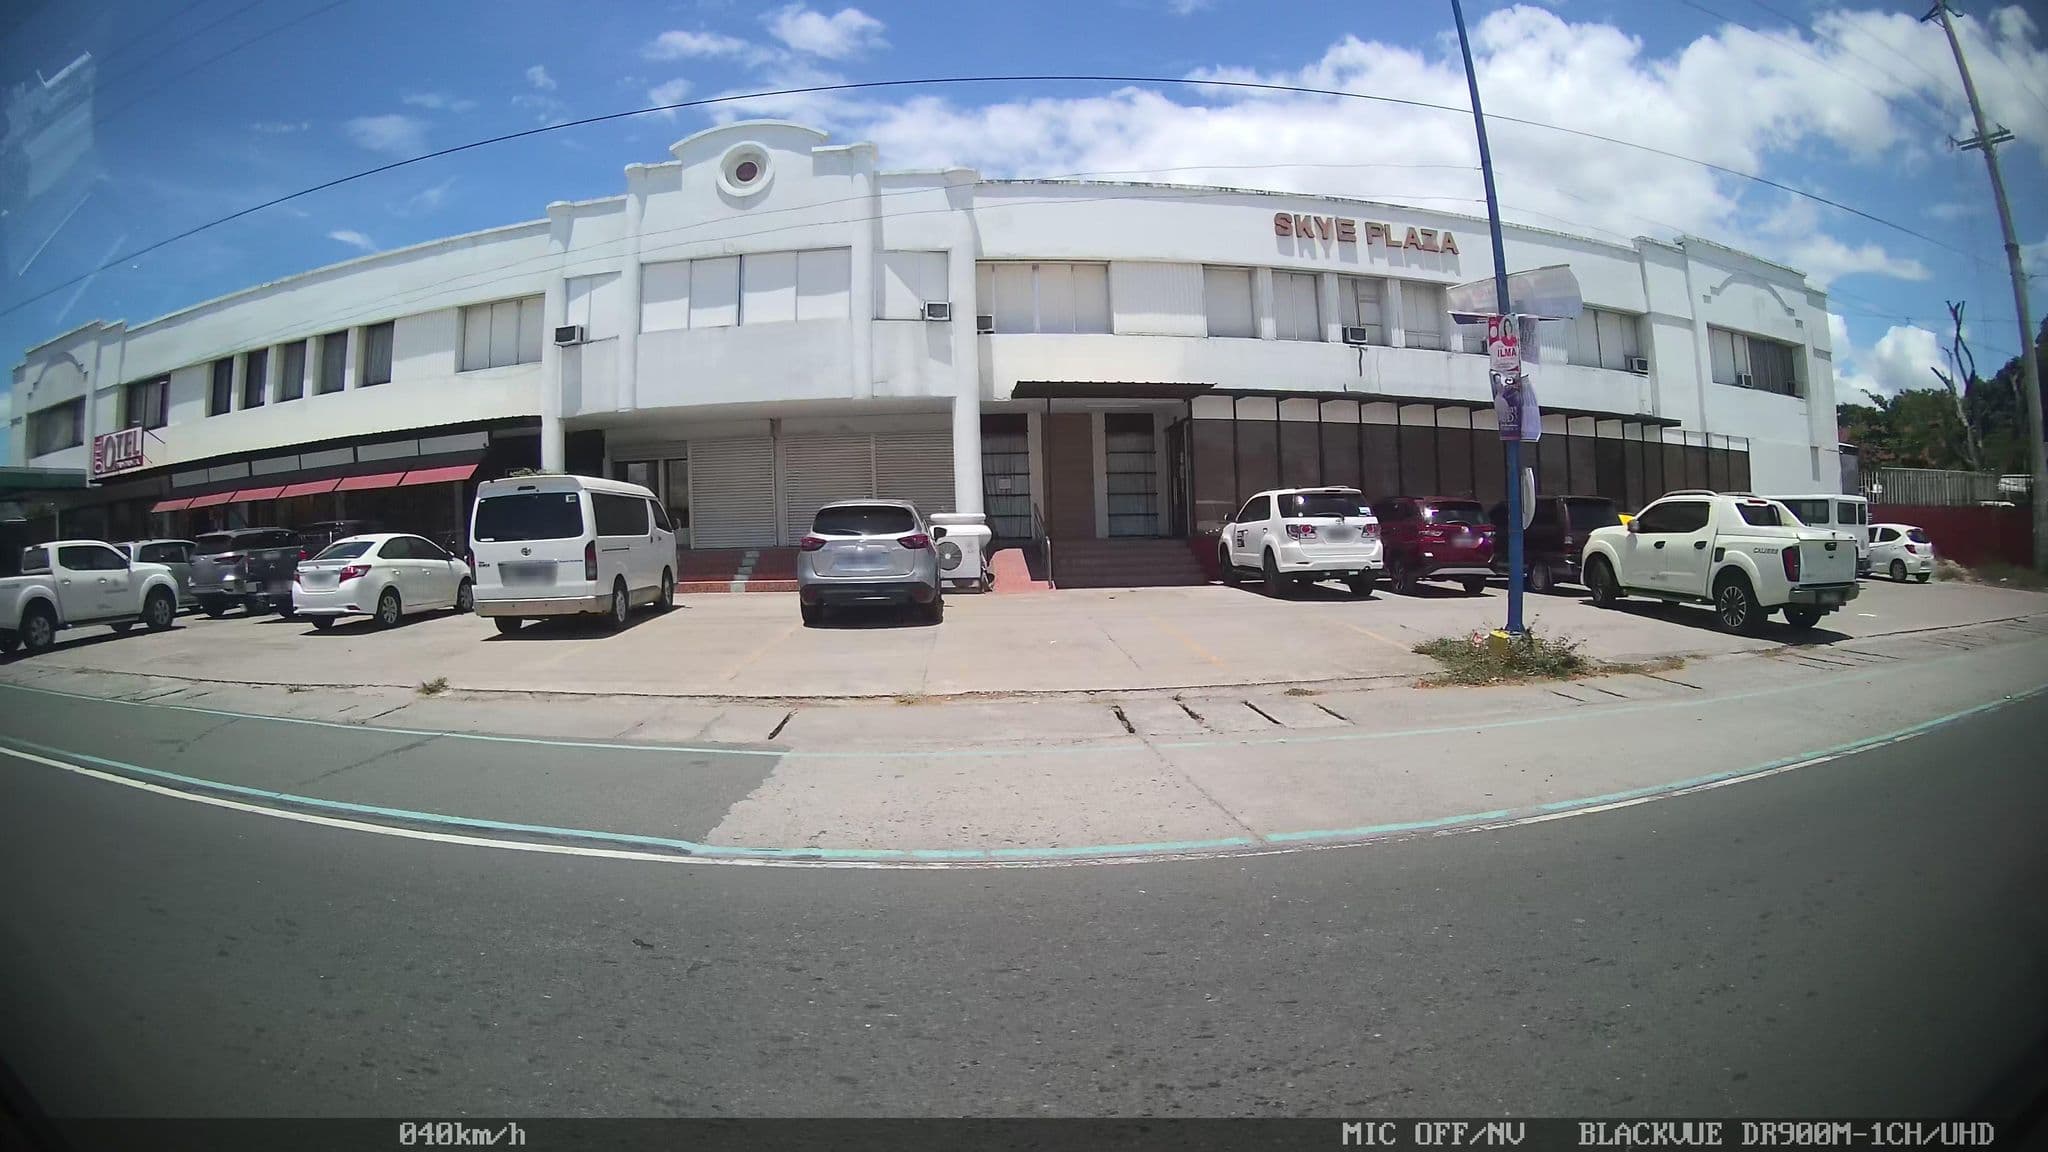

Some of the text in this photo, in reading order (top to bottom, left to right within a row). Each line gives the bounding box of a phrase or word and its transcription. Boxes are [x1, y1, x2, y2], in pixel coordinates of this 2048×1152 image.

[1274, 212, 1460, 255] SKYE PLAZA
[1497, 347, 1517, 357] ILMA
